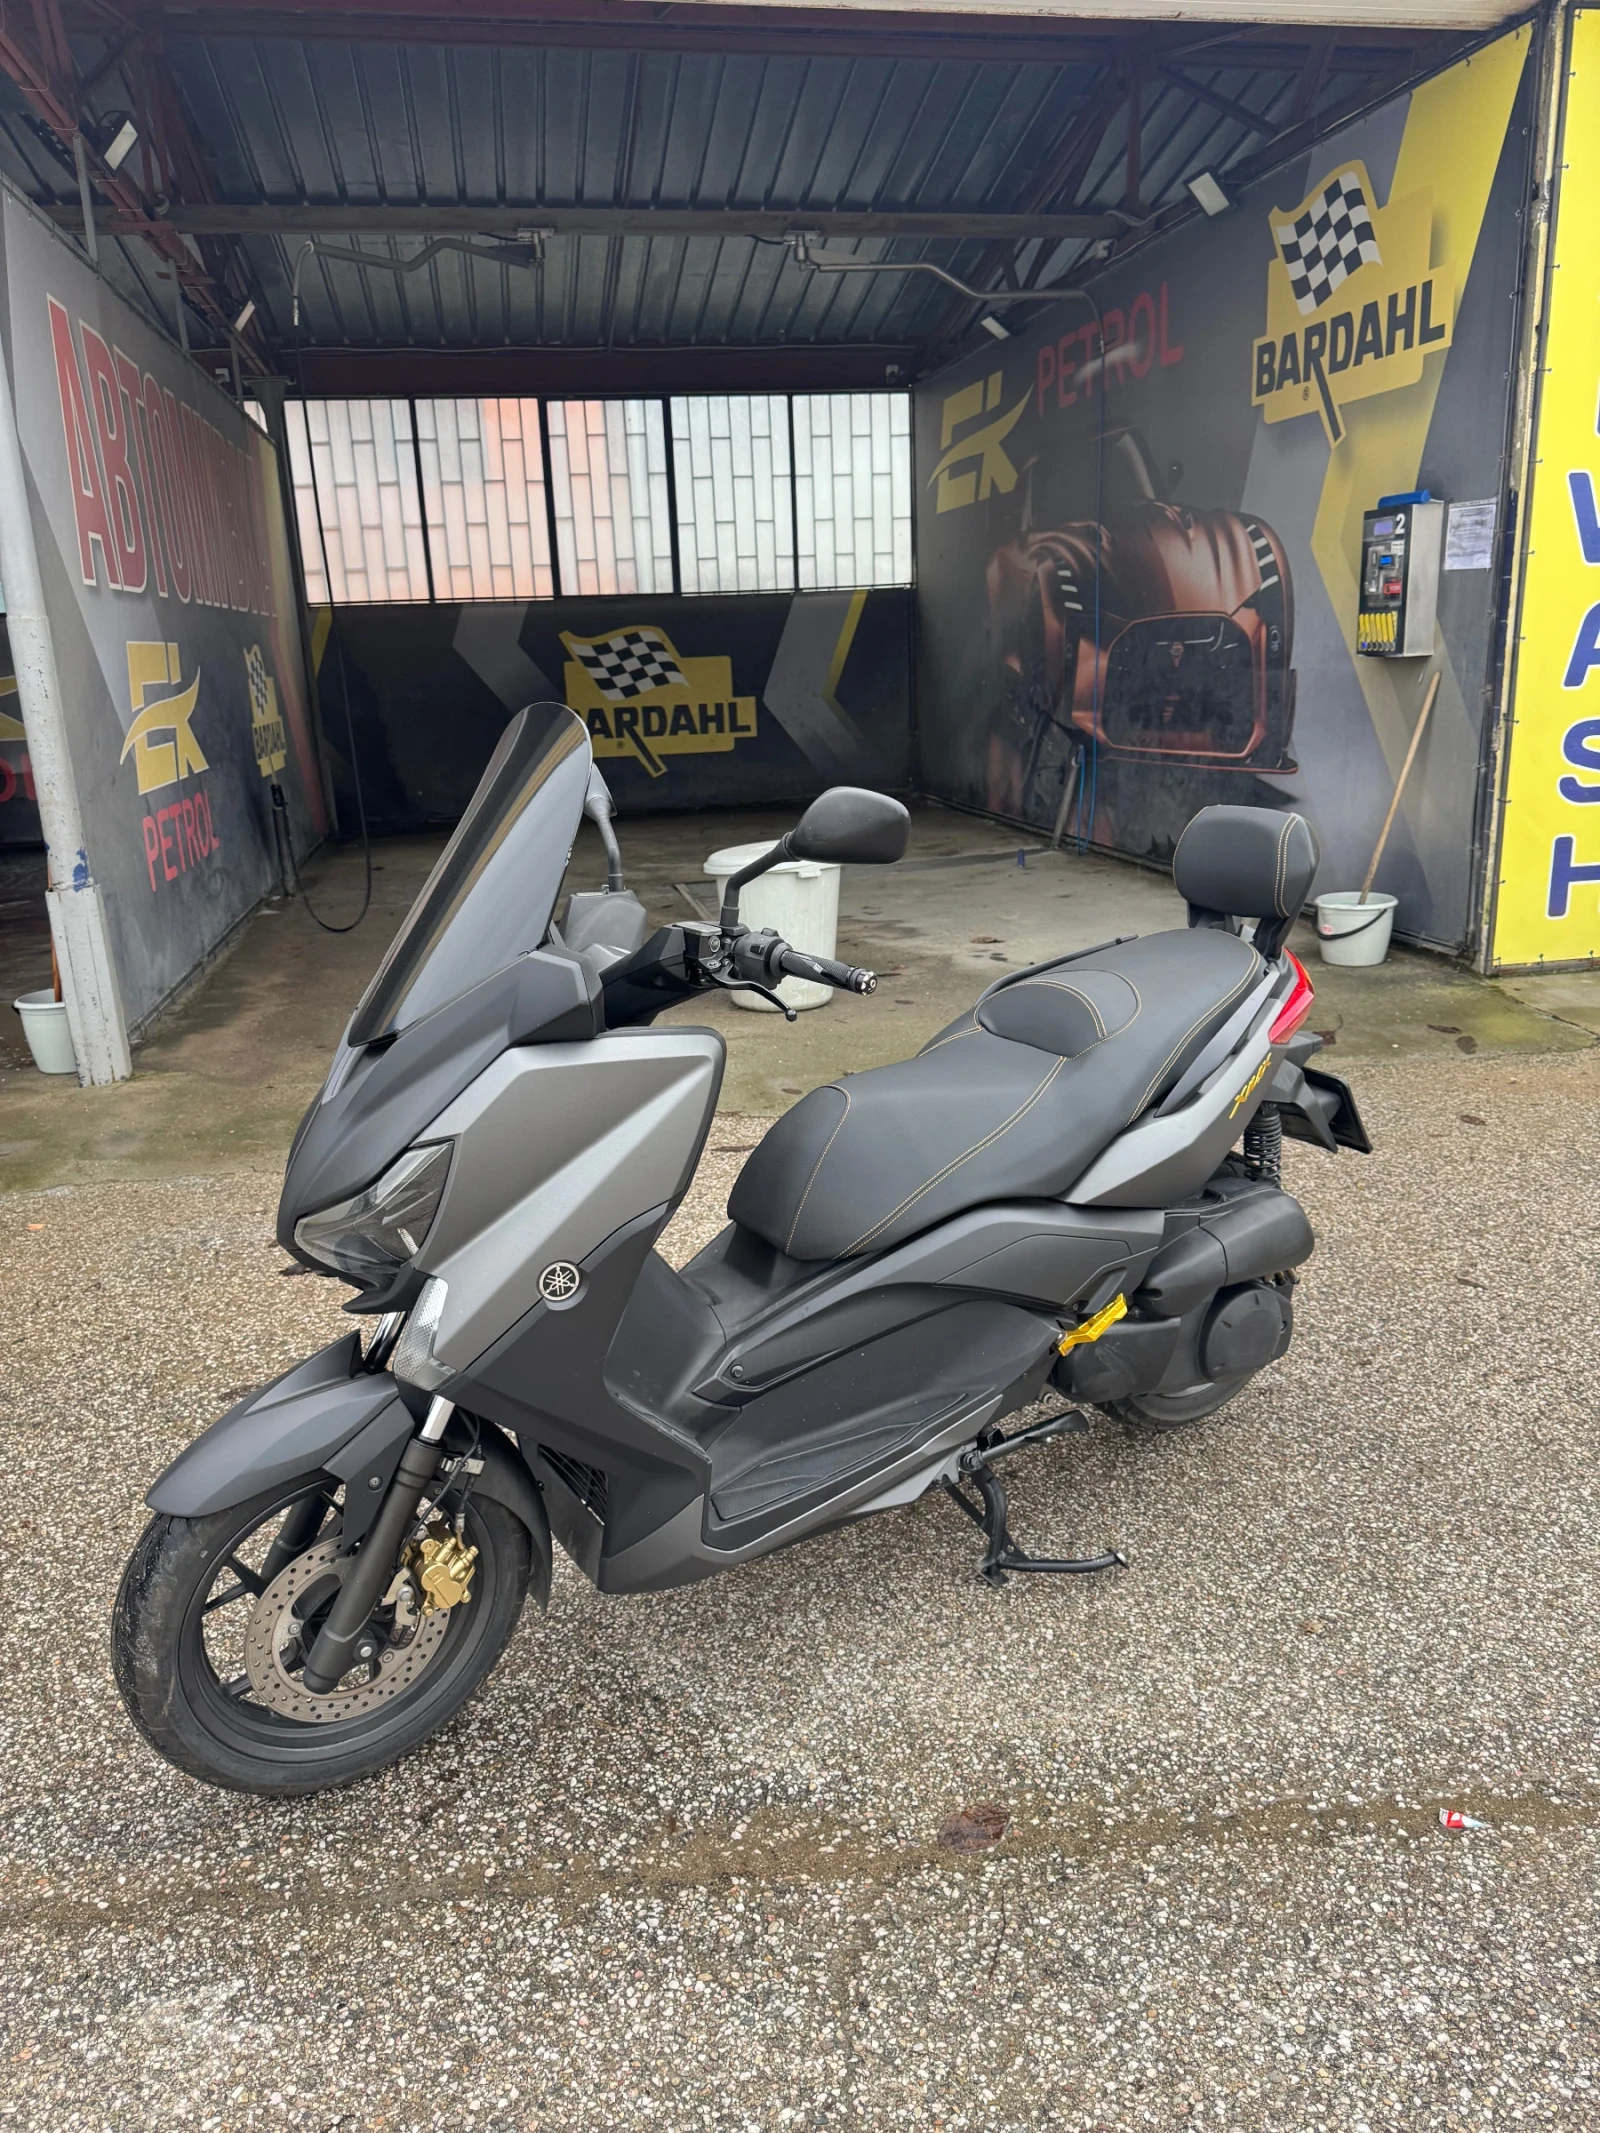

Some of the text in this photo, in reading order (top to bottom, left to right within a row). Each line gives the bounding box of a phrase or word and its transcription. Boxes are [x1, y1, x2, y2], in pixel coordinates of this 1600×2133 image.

[1037, 281, 1185, 417] PETROL
[1256, 279, 1446, 397] BARDAHL
[1395, 513, 1406, 535] 2
[576, 701, 752, 740] ARDAHL
[142, 788, 220, 892] PETROL
